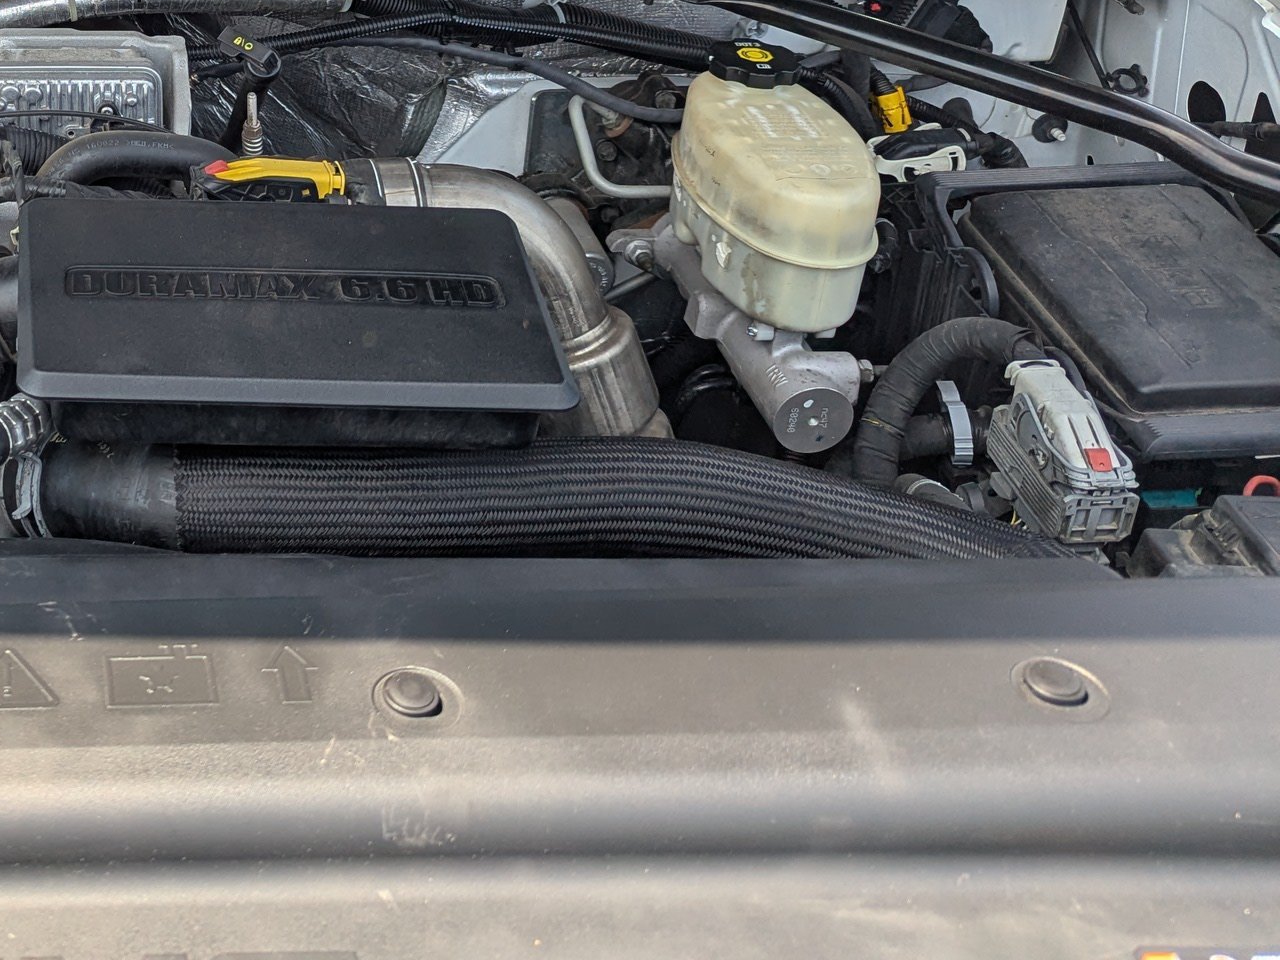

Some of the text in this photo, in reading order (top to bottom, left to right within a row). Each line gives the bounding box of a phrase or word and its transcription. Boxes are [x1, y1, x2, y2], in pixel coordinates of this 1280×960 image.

[71, 272, 498, 306] DURAMAX 6.6 HD
